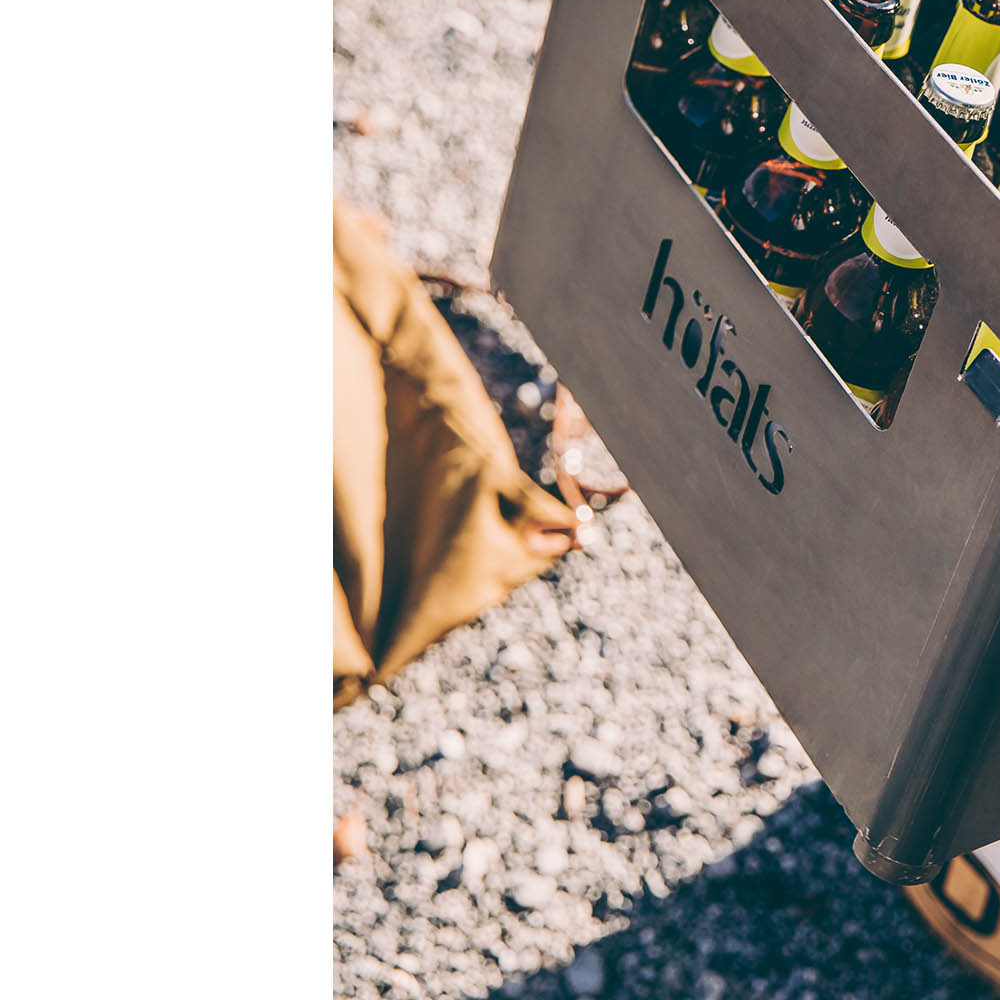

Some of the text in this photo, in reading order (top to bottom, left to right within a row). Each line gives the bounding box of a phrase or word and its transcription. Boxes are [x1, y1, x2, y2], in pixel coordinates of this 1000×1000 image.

[936, 72, 991, 87] Zötler Bier
[641, 239, 793, 496] höfats
